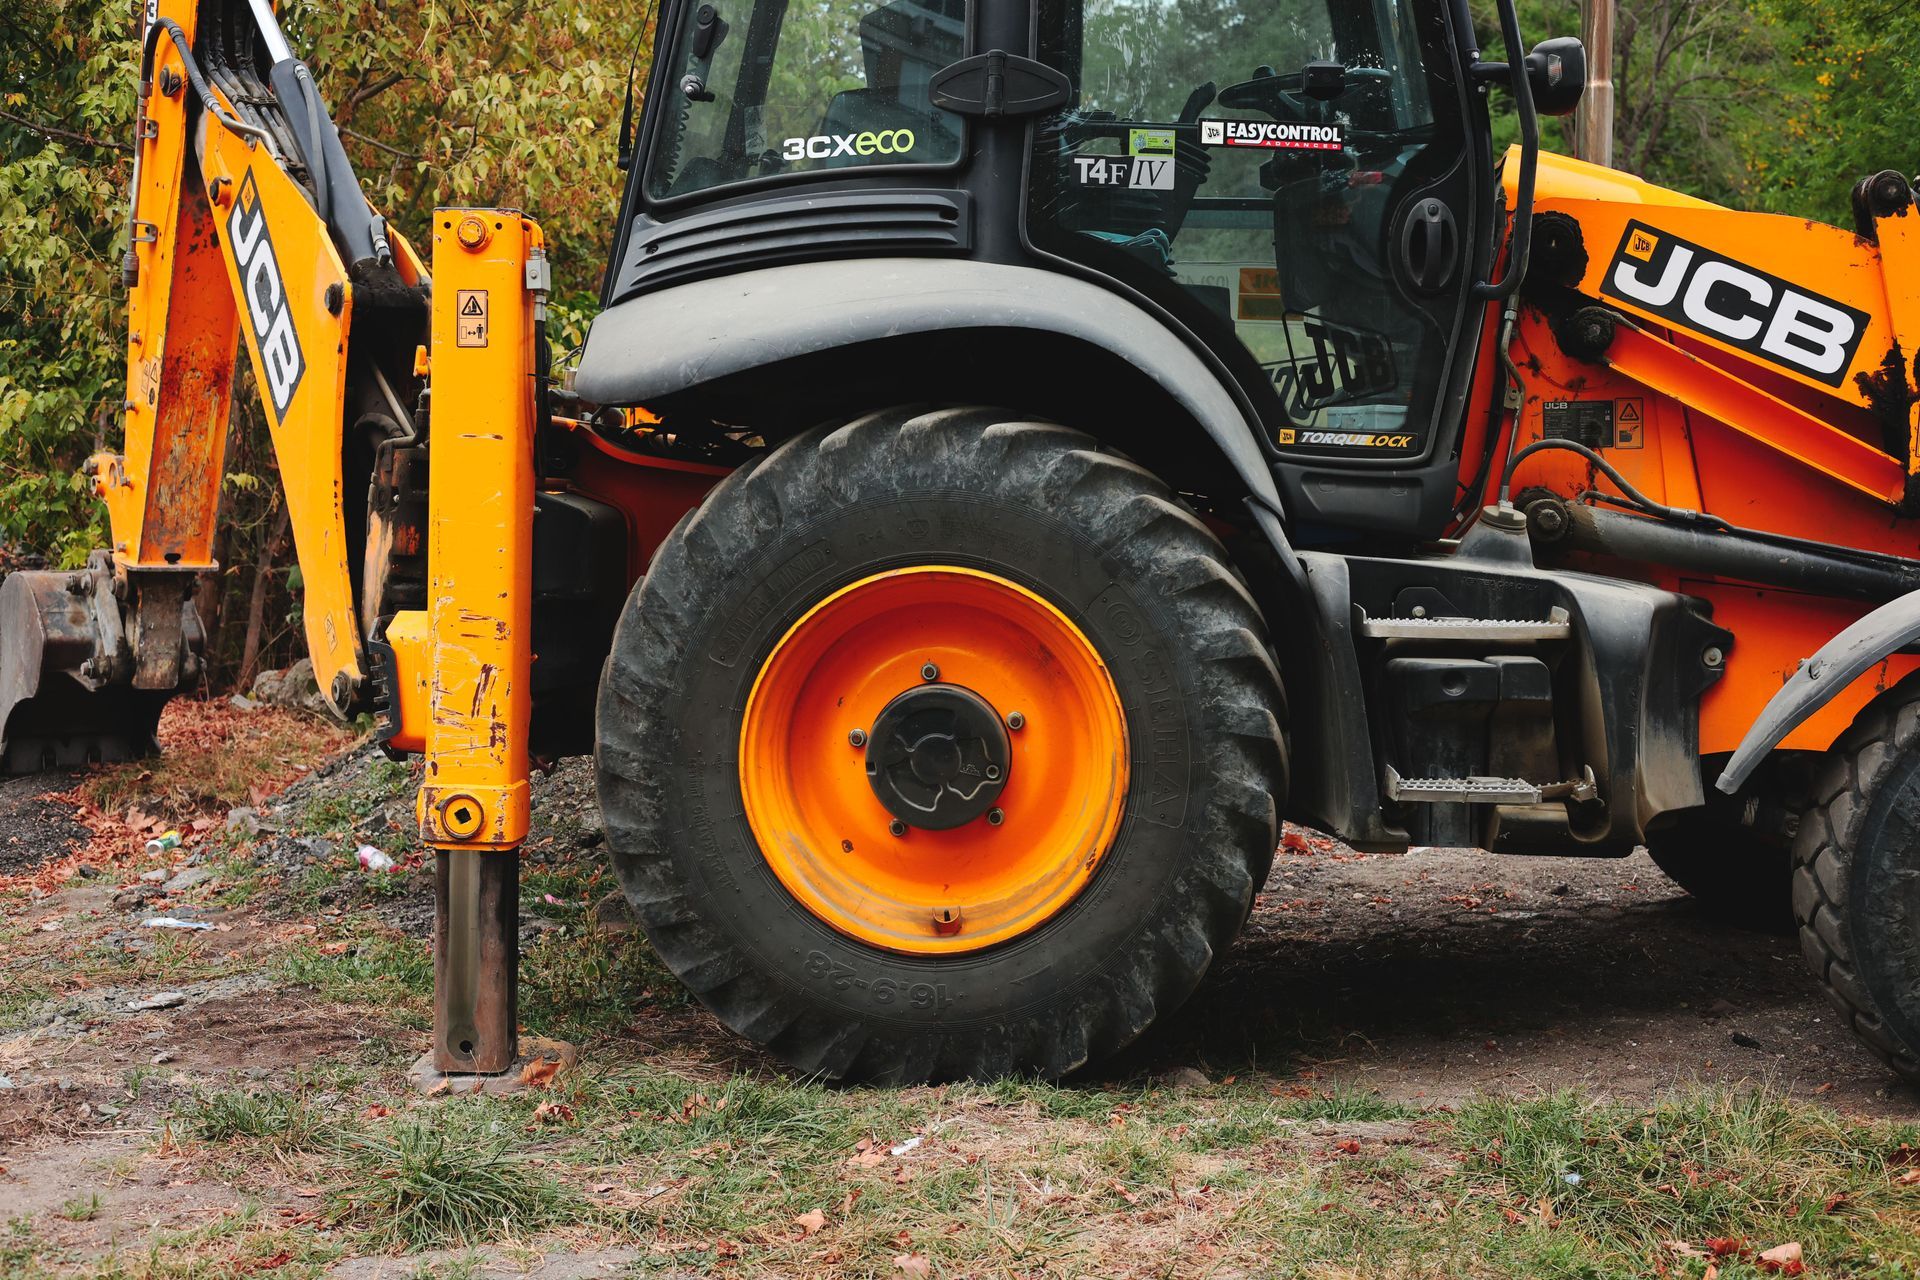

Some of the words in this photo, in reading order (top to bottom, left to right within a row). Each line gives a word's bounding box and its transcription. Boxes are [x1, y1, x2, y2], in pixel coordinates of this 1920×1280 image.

[783, 129, 915, 161] 3CXeco
[1227, 122, 1341, 144] EASYCONTROL
[1266, 141, 1338, 149] ADVANCED
[1074, 157, 1127, 185] T4F
[1133, 160, 1168, 186] IV
[1635, 237, 1650, 251] JCB
[232, 204, 299, 409] JCB
[1613, 244, 1855, 374] JCB
[1544, 402, 1568, 410] JCB
[1301, 432, 1413, 447] TORQUELOCK
[804, 951, 952, 1009] 16.9-28
